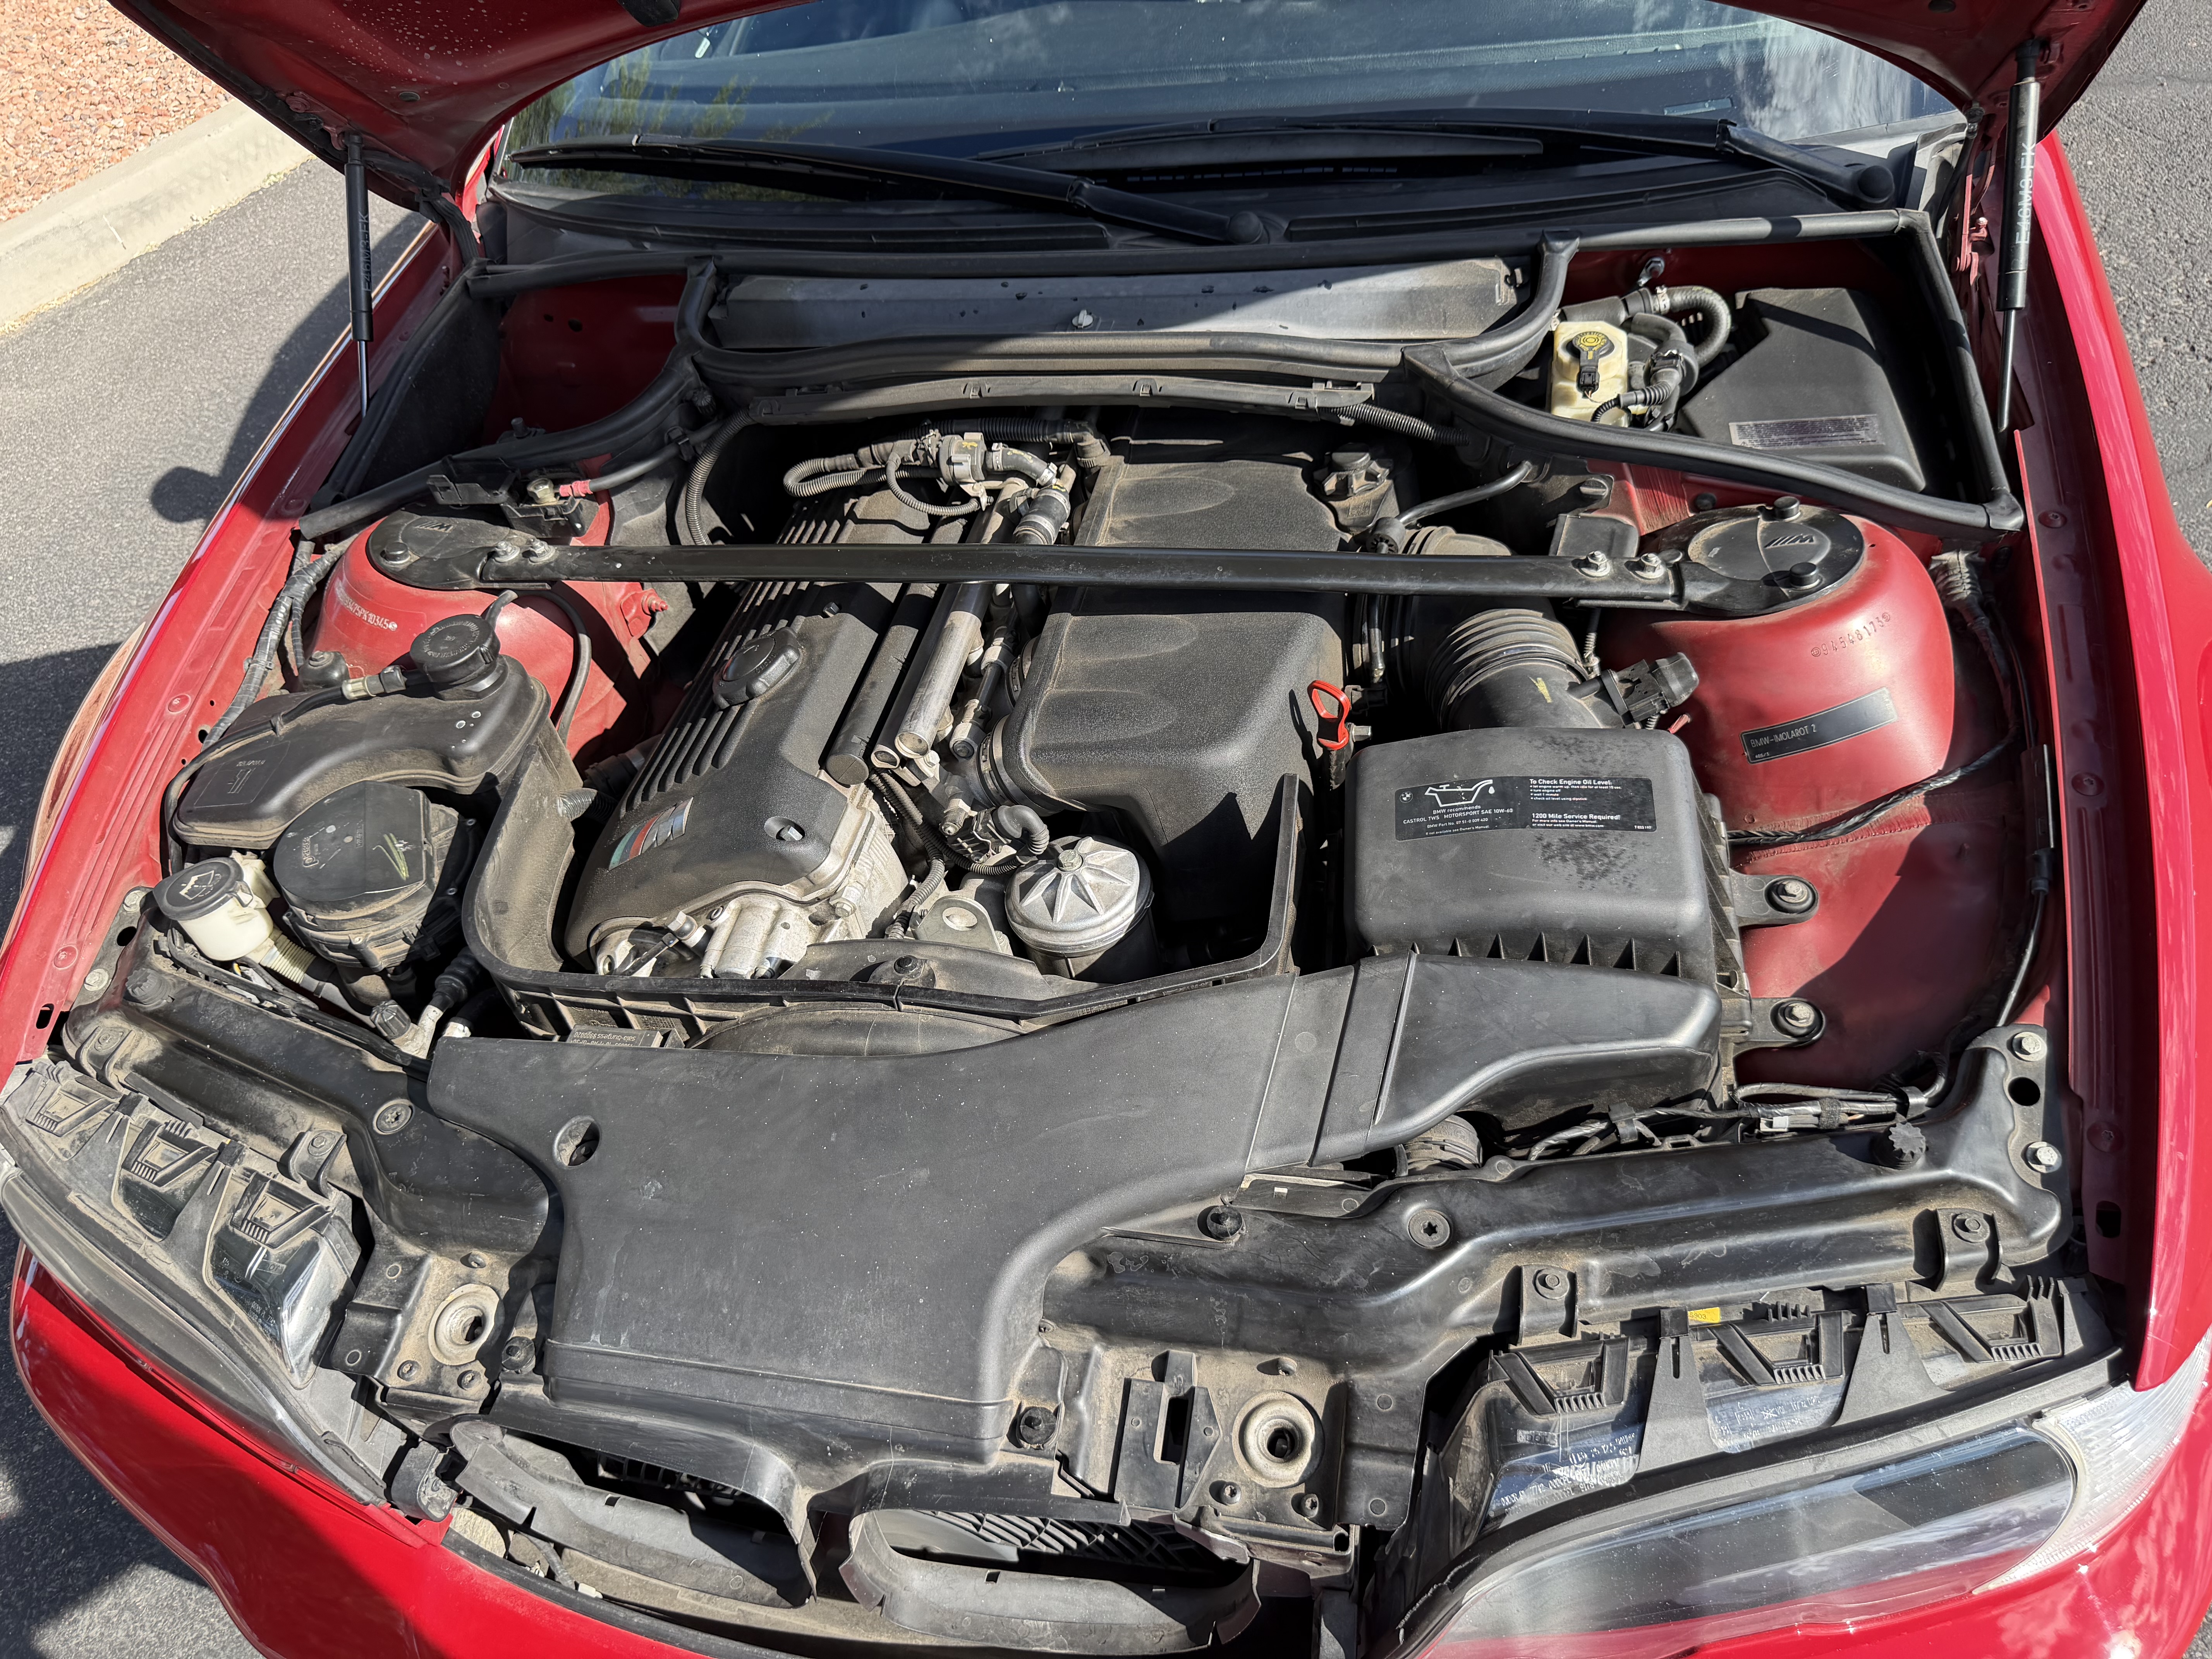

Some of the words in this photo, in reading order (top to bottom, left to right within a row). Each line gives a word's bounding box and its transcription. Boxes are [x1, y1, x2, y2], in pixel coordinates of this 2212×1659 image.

[1750, 726, 1809, 748] BMW-IMOLAROT
[1811, 724, 1817, 733] 2
[1448, 805, 1481, 813] recommends
[1444, 810, 1479, 819] MOTORSPORT
